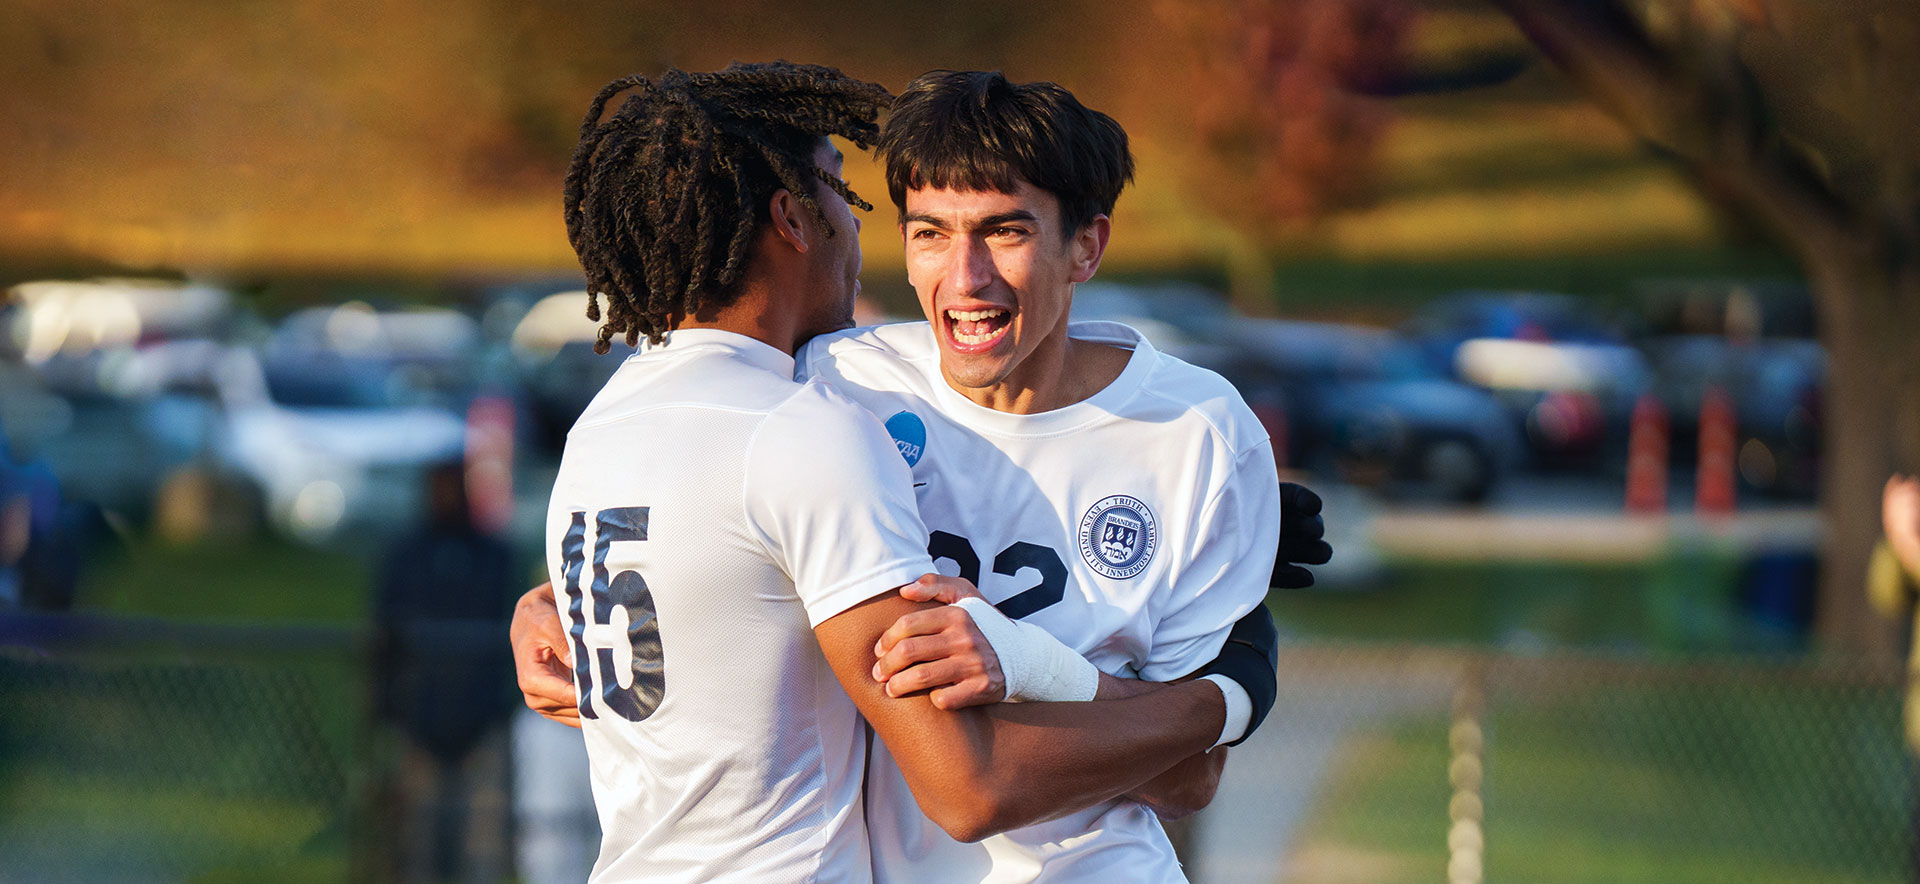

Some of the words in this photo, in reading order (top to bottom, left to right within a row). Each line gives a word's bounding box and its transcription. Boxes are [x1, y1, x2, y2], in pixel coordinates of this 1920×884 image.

[893, 438, 920, 460] CAA
[1113, 498, 1143, 512] TRUTH
[1084, 506, 1102, 527] EVEN
[1107, 515, 1139, 530] BRANDEIS
[1081, 531, 1092, 557] UNTO
[1147, 521, 1155, 549] PARTS
[1090, 558, 1103, 571] ITS
[1106, 552, 1151, 577] INNERMOST
[561, 507, 665, 722] 15
